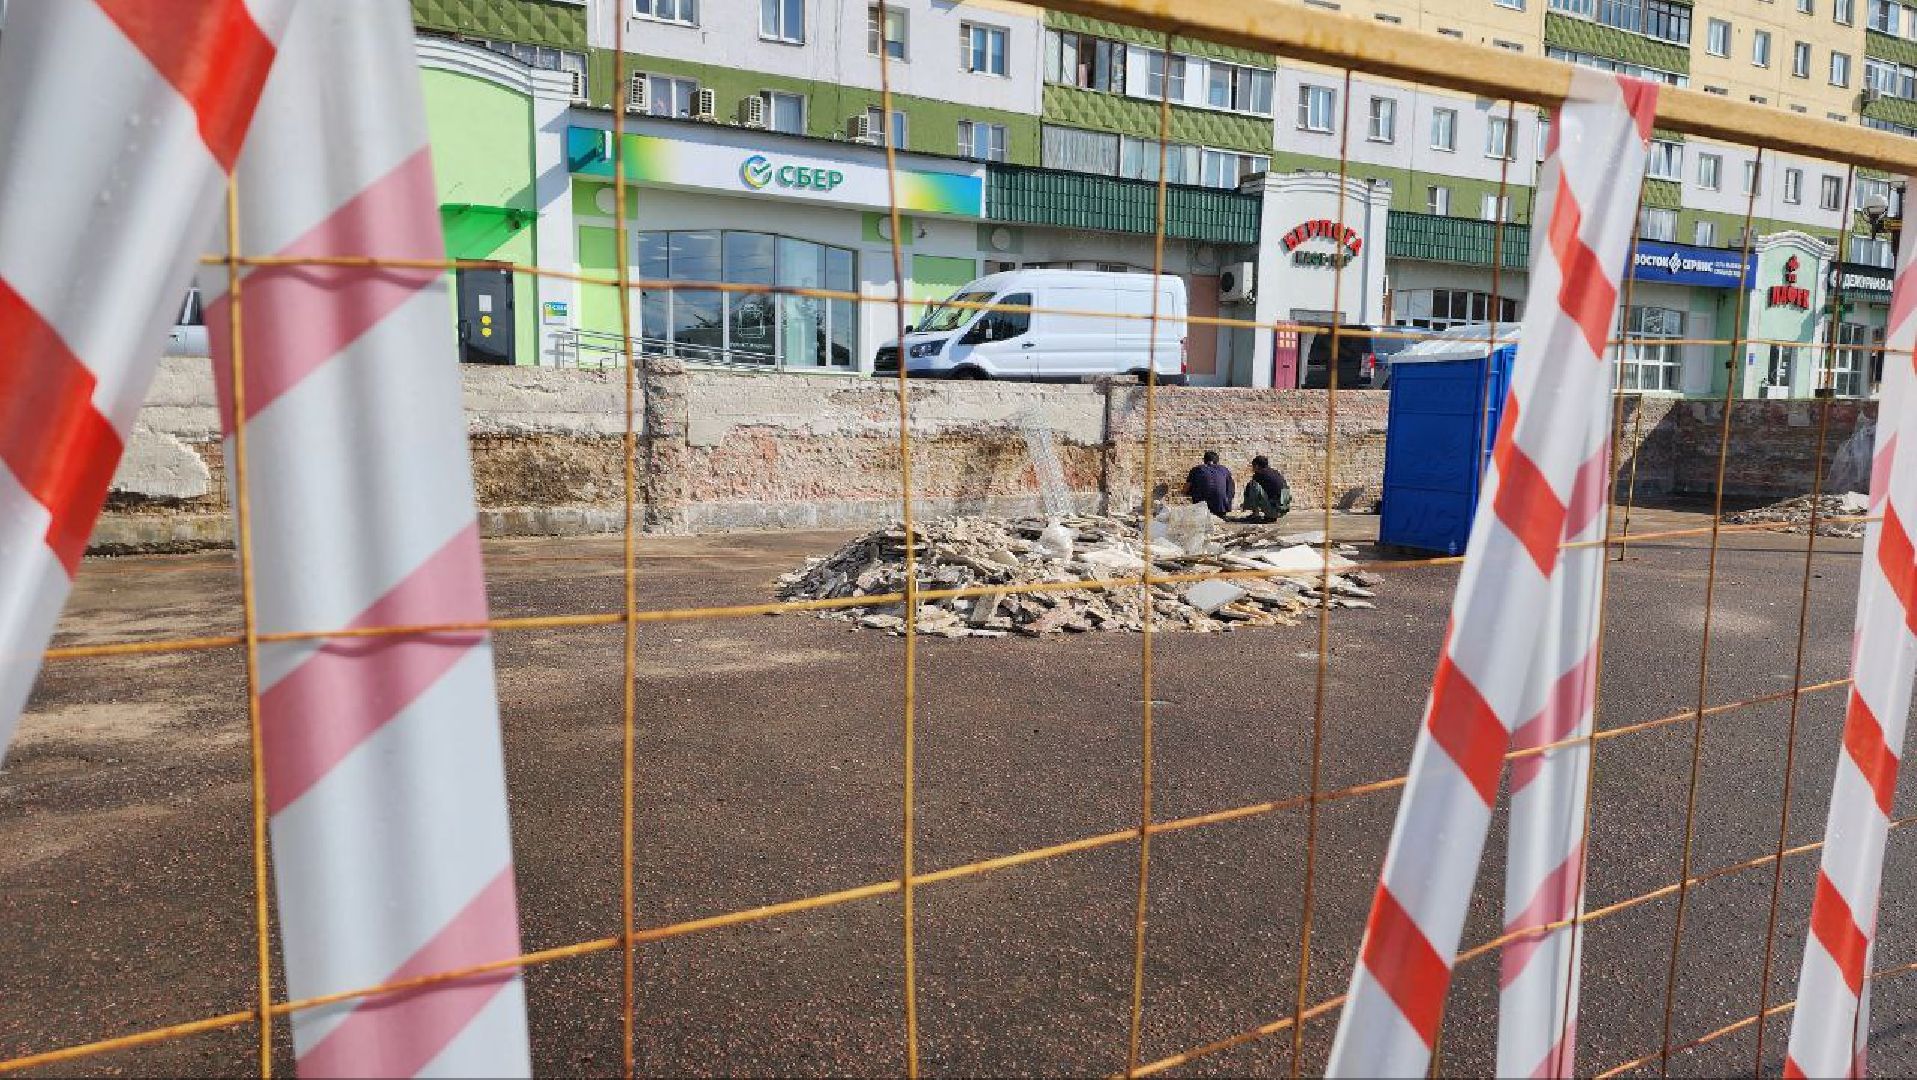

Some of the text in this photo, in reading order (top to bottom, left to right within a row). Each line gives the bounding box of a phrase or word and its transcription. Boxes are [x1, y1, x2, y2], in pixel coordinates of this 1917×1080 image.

[777, 164, 844, 190] СБЕР
[1635, 253, 1669, 267] ВОСТОК
[1682, 258, 1714, 272] СЕРВИС
[1842, 273, 1887, 290] ДЕЖУРНАЯ
